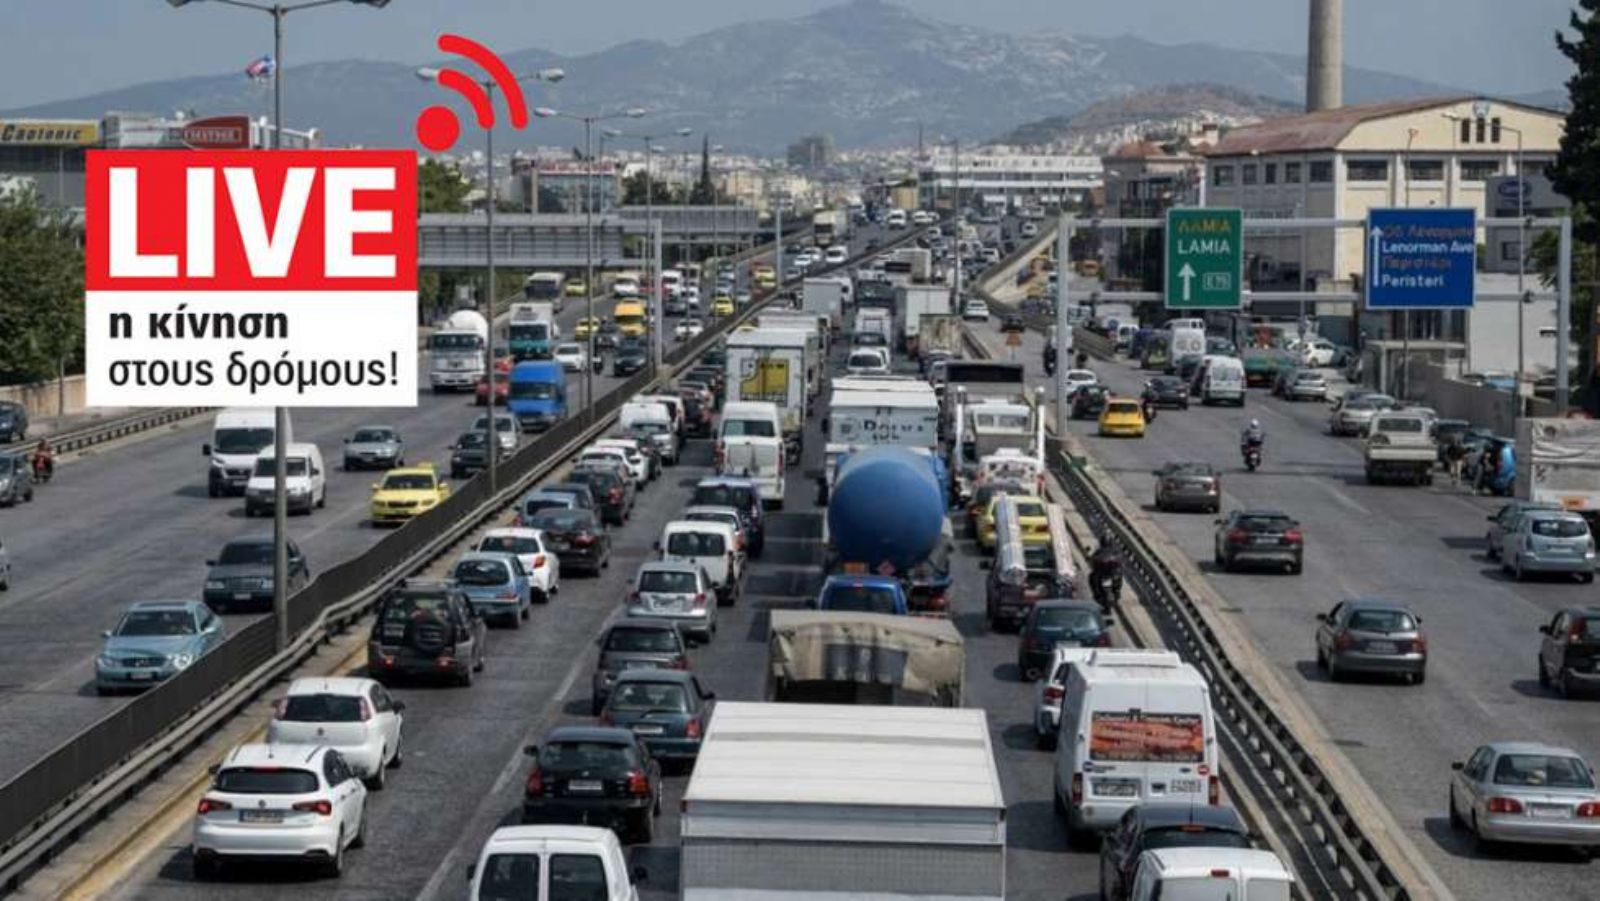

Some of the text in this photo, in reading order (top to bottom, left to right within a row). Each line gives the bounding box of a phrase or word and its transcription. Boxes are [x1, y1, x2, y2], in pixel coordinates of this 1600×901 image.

[1177, 238, 1231, 255] LAMIA
[1382, 240, 1447, 253] Lenorman
[1382, 273, 1444, 288] Peristeri
